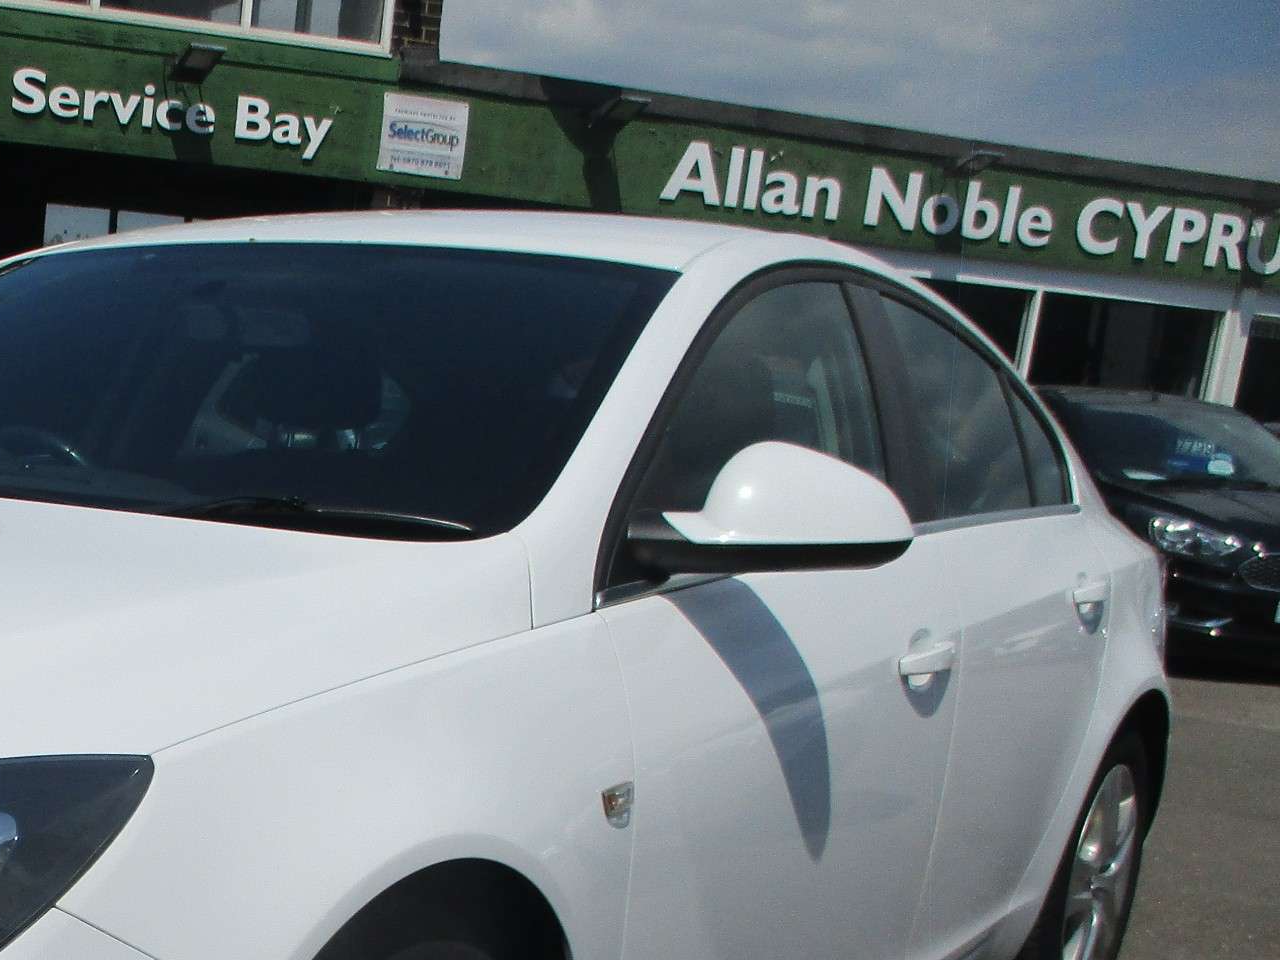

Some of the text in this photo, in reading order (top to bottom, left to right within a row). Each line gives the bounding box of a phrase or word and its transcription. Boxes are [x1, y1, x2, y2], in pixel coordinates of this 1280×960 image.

[12, 68, 333, 160] Service Bay
[388, 123, 459, 152] SelectGroup
[660, 141, 840, 220] Allan
[863, 166, 1053, 247] Noble
